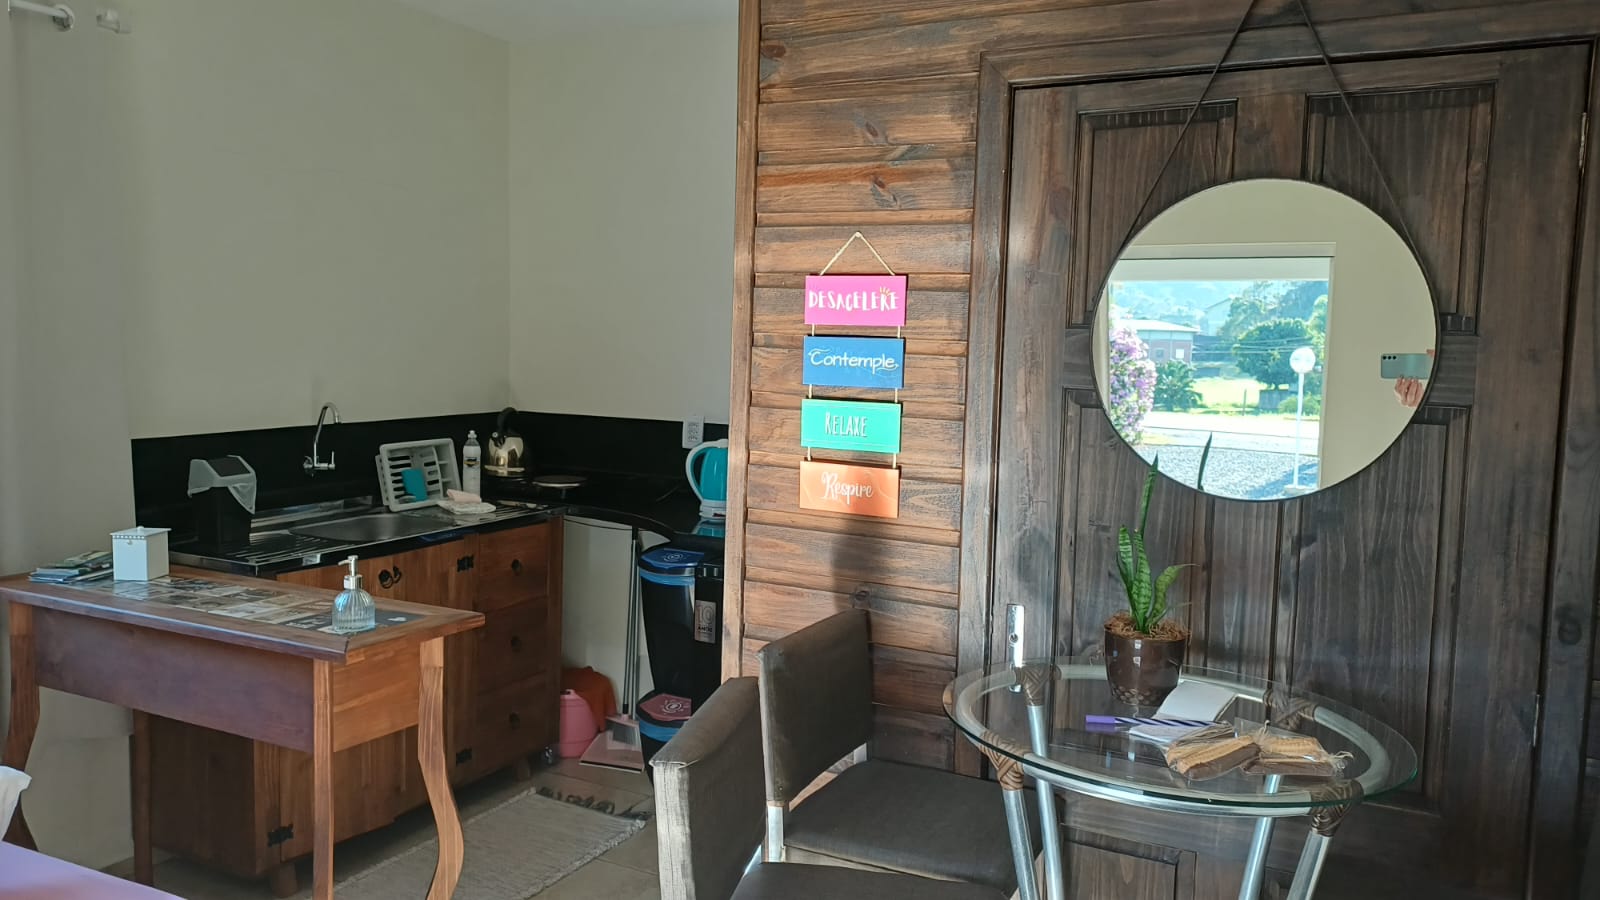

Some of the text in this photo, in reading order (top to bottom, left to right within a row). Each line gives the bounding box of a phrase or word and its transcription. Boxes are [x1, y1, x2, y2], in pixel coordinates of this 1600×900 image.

[808, 290, 899, 312] DESACELERE
[808, 350, 899, 374] Contemple
[825, 411, 868, 438] RELAXE
[821, 471, 873, 504] Respire
